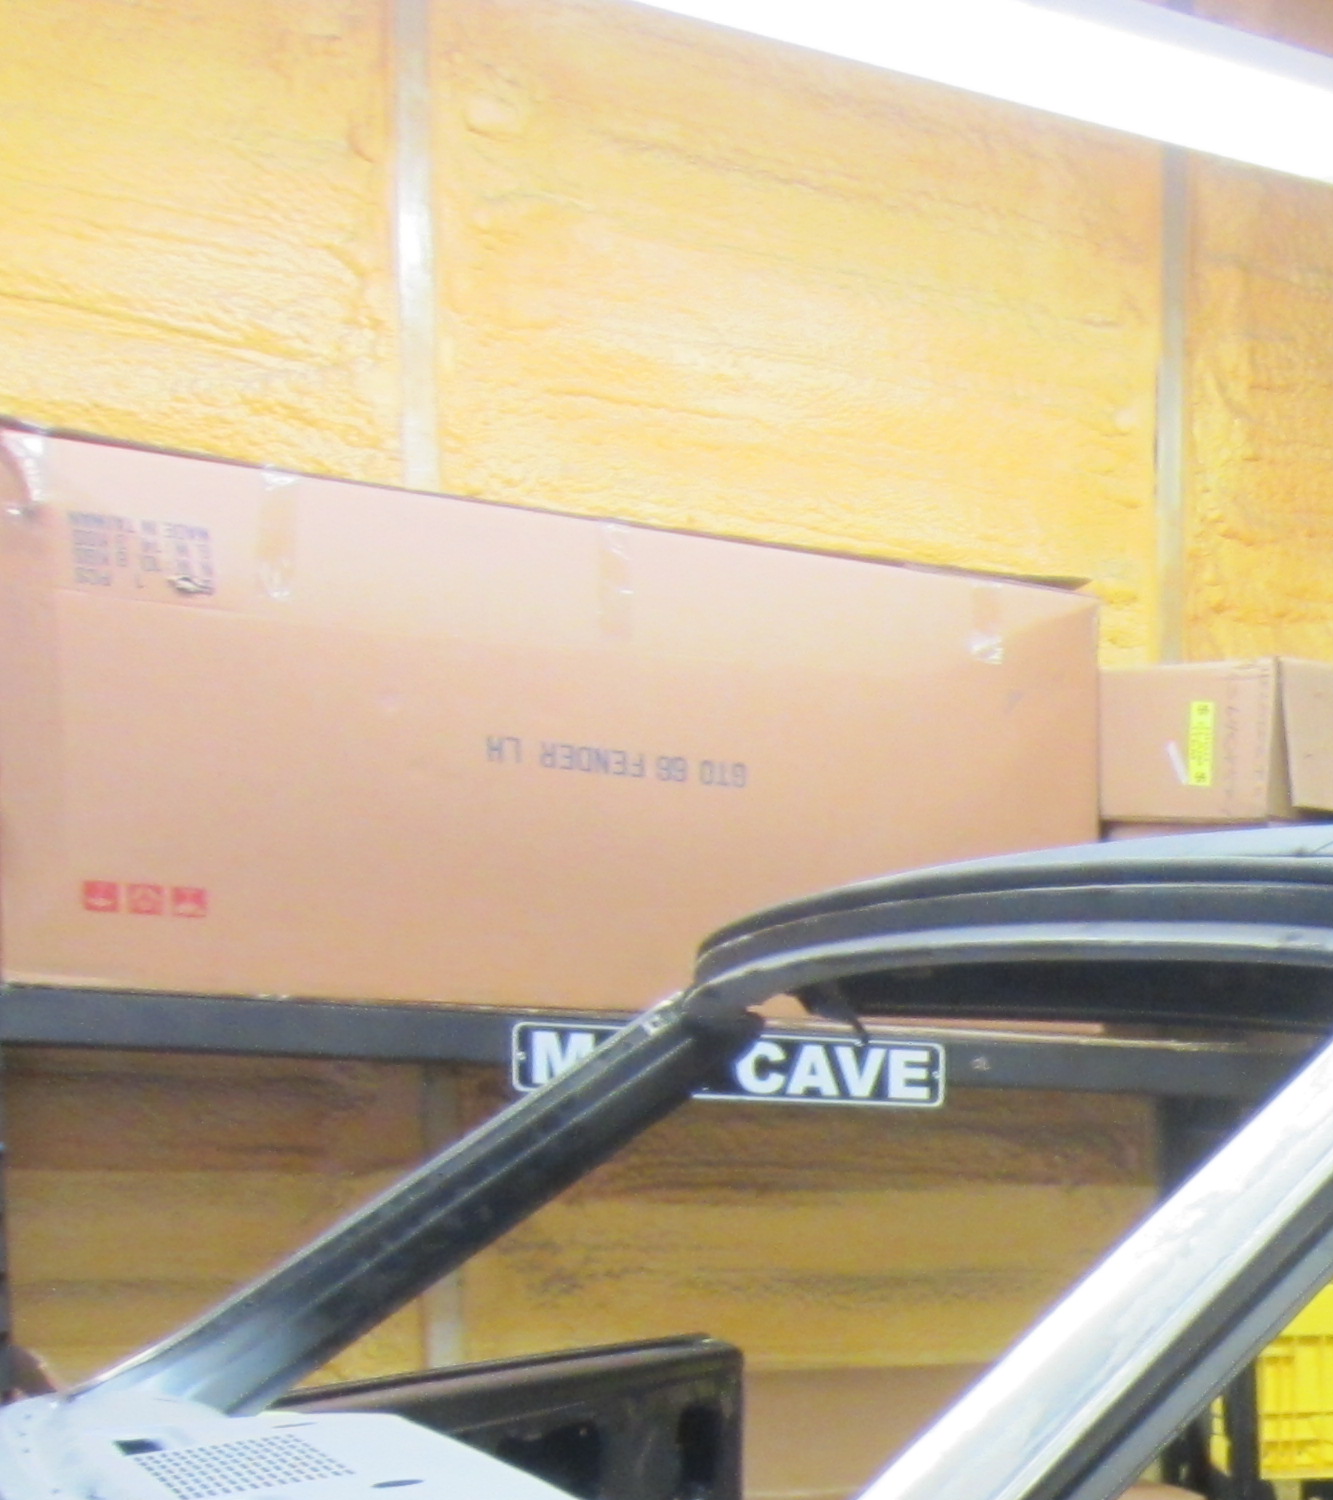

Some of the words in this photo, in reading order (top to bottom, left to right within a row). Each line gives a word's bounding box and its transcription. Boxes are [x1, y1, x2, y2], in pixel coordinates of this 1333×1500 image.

[486, 735, 522, 764] LH
[539, 740, 646, 778] FENDER
[699, 758, 747, 788] GTO
[735, 1039, 932, 1100] CAVE
